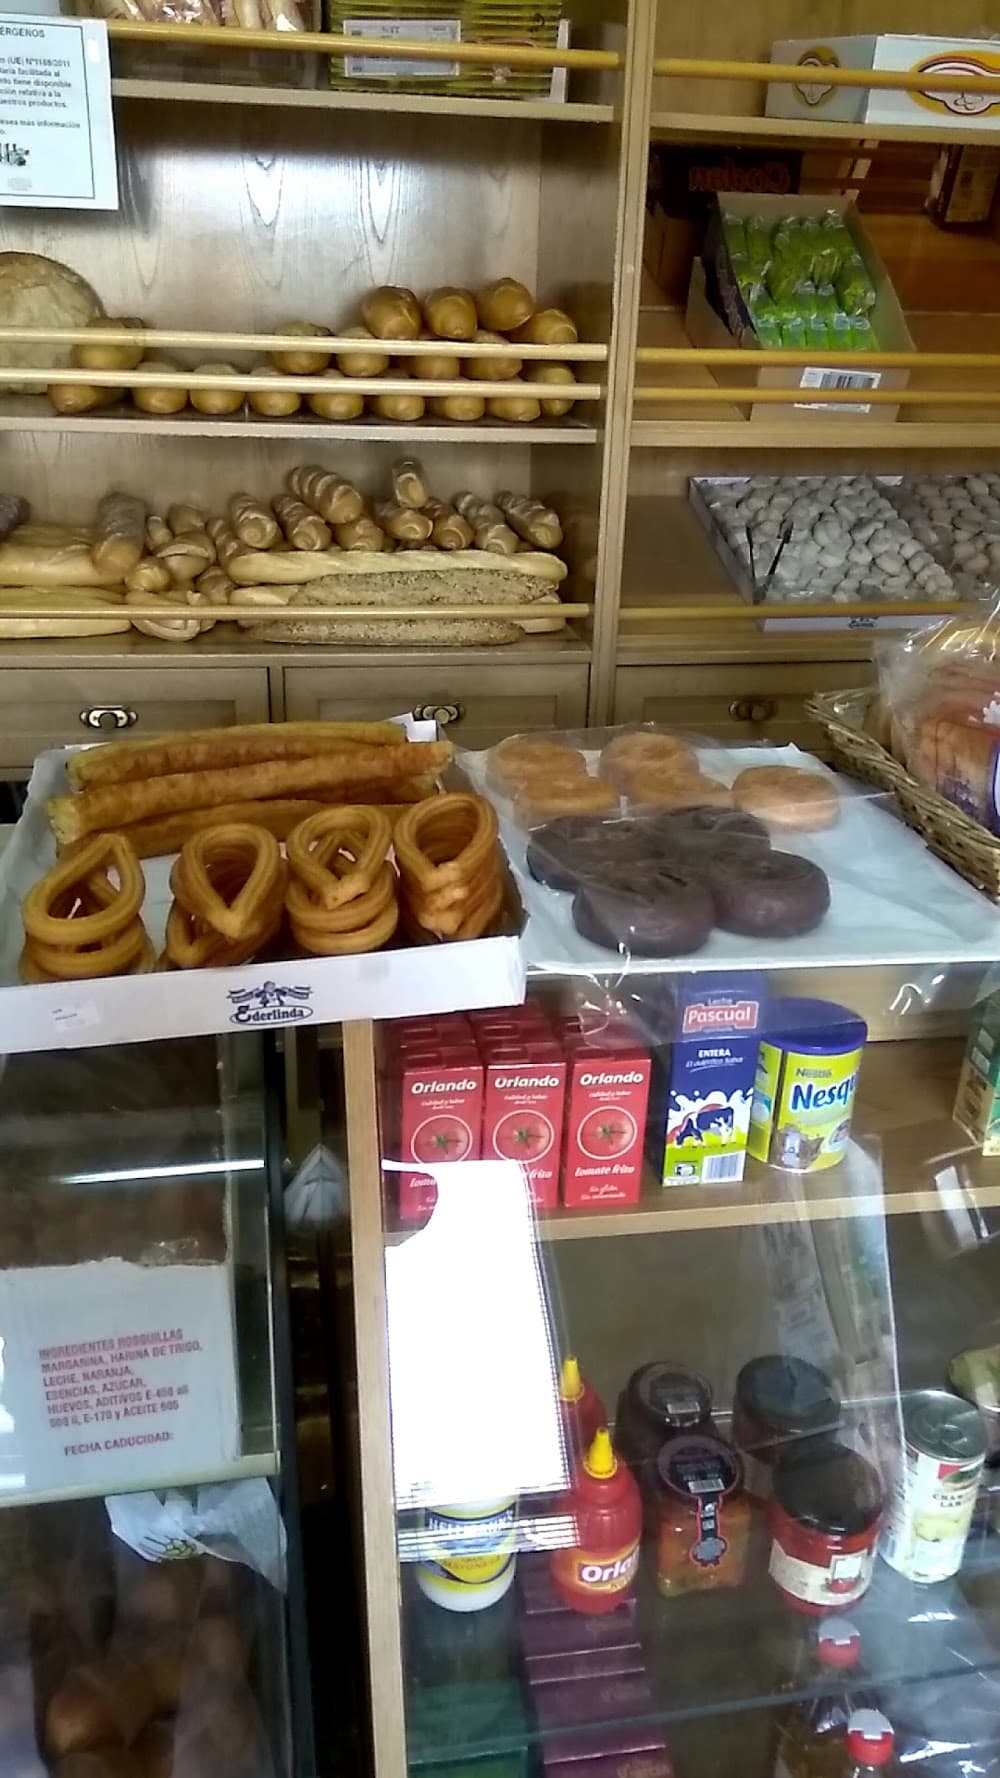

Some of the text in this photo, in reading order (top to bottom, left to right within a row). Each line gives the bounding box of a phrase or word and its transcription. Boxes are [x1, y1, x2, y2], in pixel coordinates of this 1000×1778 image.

[235, 1005, 305, 1023] Ederlinda
[688, 1006, 751, 1025] Pascual
[698, 1048, 731, 1058] ENTERA
[494, 1075, 559, 1089] Orlando
[580, 1071, 644, 1086] Orlando
[411, 1079, 477, 1095] Orlando
[110, 1347, 150, 1363] HARINA
[152, 1345, 167, 1358] DE
[96, 1391, 142, 1407] ADITIVOS
[123, 1402, 157, 1417] ACEITE
[64, 1441, 102, 1457] FECHA
